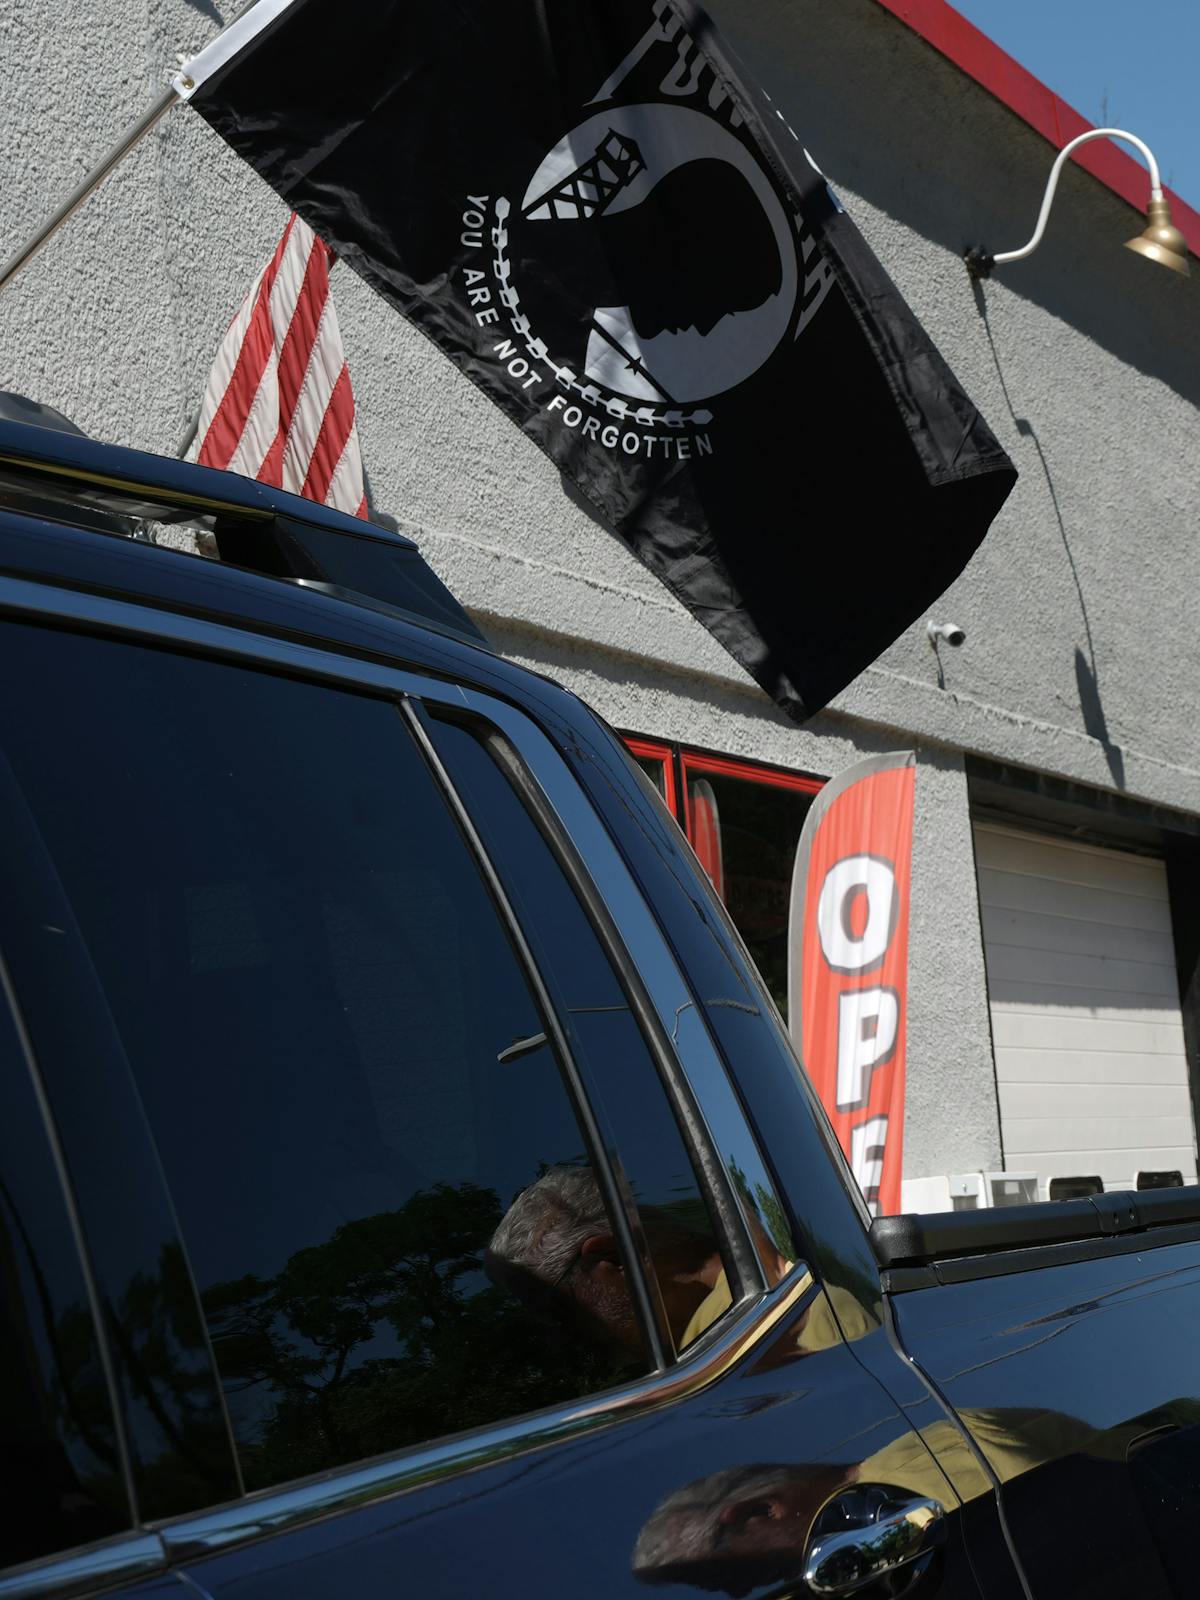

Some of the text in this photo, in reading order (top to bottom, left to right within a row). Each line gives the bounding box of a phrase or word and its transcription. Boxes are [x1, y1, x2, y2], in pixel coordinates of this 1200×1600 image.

[460, 195, 713, 460] YOU ARE NOT FORGOTTEN
